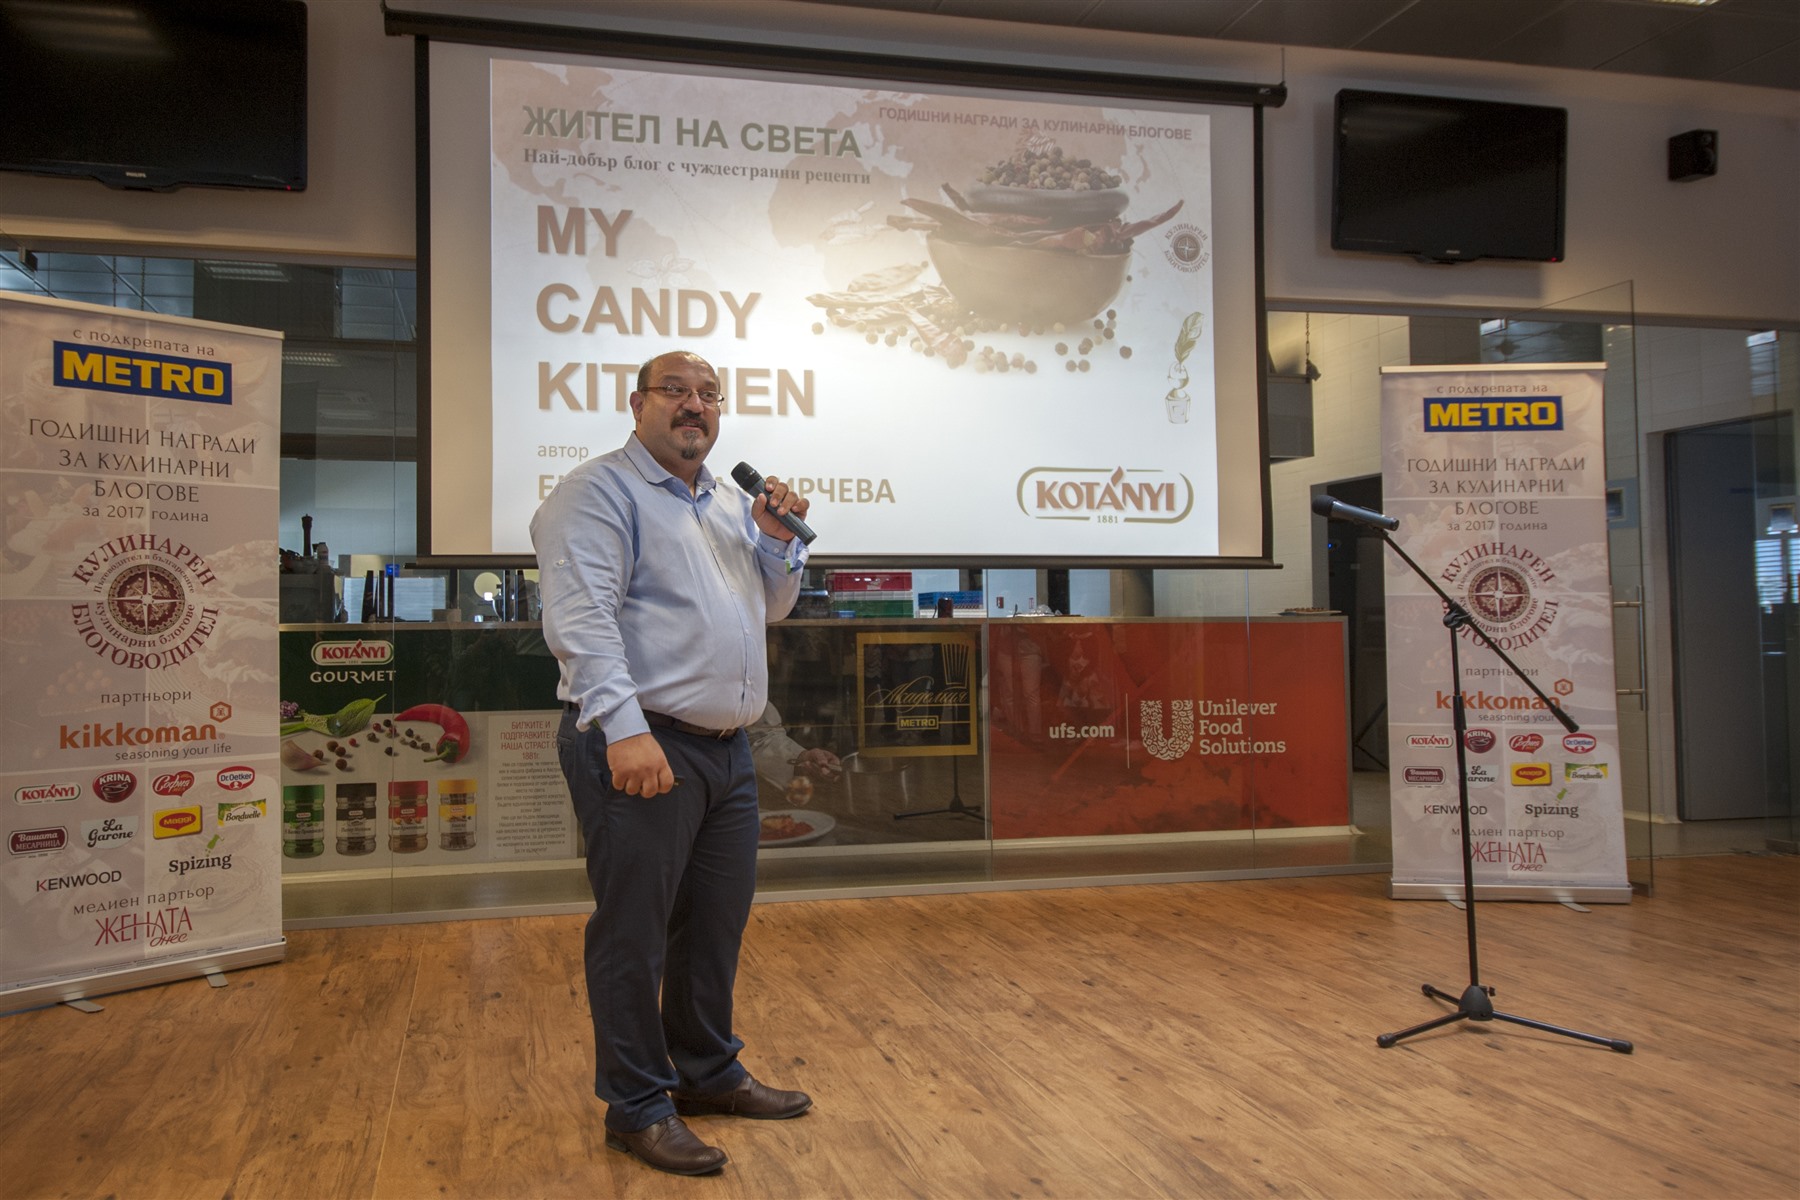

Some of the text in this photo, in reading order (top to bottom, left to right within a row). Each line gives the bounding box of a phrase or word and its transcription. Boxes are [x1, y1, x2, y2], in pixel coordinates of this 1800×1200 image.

[522, 105, 862, 159] ЖИТЕЛ НА СВЕТА
[879, 106, 1192, 141] ГОДИШНИ НАГРАДИ ЗА КУЛИНАРНИ БЛОГОВЕ
[524, 147, 872, 185] Най-добър блог с чуждестранни рецепти
[537, 204, 634, 258] MY
[536, 283, 761, 340] CANDY
[73, 329, 215, 356] с подкрепата на
[62, 349, 224, 397] METRO
[537, 361, 816, 418] KITEN
[1449, 384, 1526, 395] подкрепата
[1533, 384, 1547, 392] на
[1429, 401, 1557, 427] METRO
[28, 418, 255, 454] ГОДИШНИ НАГРАДИ
[537, 444, 590, 463] автор
[59, 450, 229, 478] ЗА КУЛИНАРНИ
[1408, 457, 1585, 473] ГОДИШНИ НАГРАДИ
[95, 480, 199, 503] БЛОГОВЕ
[1036, 466, 1175, 511] KOTÁNYI
[1429, 479, 1564, 494] ЗА КУЛИНАРНИ
[82, 505, 209, 523] за 2017 година
[1455, 501, 1539, 515] БЛОГОВЕ
[1097, 516, 1119, 524] 1881
[1447, 521, 1547, 531] за 2017 година
[72, 534, 218, 587] КУЛИНАРЕН
[1441, 542, 1557, 583] КУЛИНАРЕН
[95, 601, 196, 648] кулинарни блогове
[71, 602, 219, 671] БЛОГОВОДИТЕЛ
[310, 670, 396, 684] GOURMET
[101, 689, 192, 706] партньори
[1436, 690, 1560, 710] kkkoman
[1199, 700, 1277, 716] Unilever
[901, 719, 935, 727] METRO
[1199, 718, 1243, 735] Food
[1478, 714, 1530, 723] seasoning
[1533, 714, 1554, 722] your
[59, 722, 217, 749] kikkoman
[1049, 722, 1114, 739] ufs.com
[115, 743, 232, 761] seasoning your life
[1199, 738, 1286, 755] Solutions
[99, 773, 131, 785] KRINA
[1471, 766, 1487, 776] La
[226, 810, 261, 822] Bonduelle
[1424, 805, 1488, 815] KENWOD
[1525, 803, 1579, 818] Spizing
[102, 818, 123, 832] La
[1451, 828, 1565, 840] мдиен партьор
[87, 829, 133, 848] Garone
[1470, 841, 1547, 864] ЖЕНАТА
[168, 854, 232, 875] Spizing
[36, 870, 122, 892] KENWOOD
[73, 886, 215, 915] медиен партьор
[94, 906, 193, 946] ЖЕНАТА
